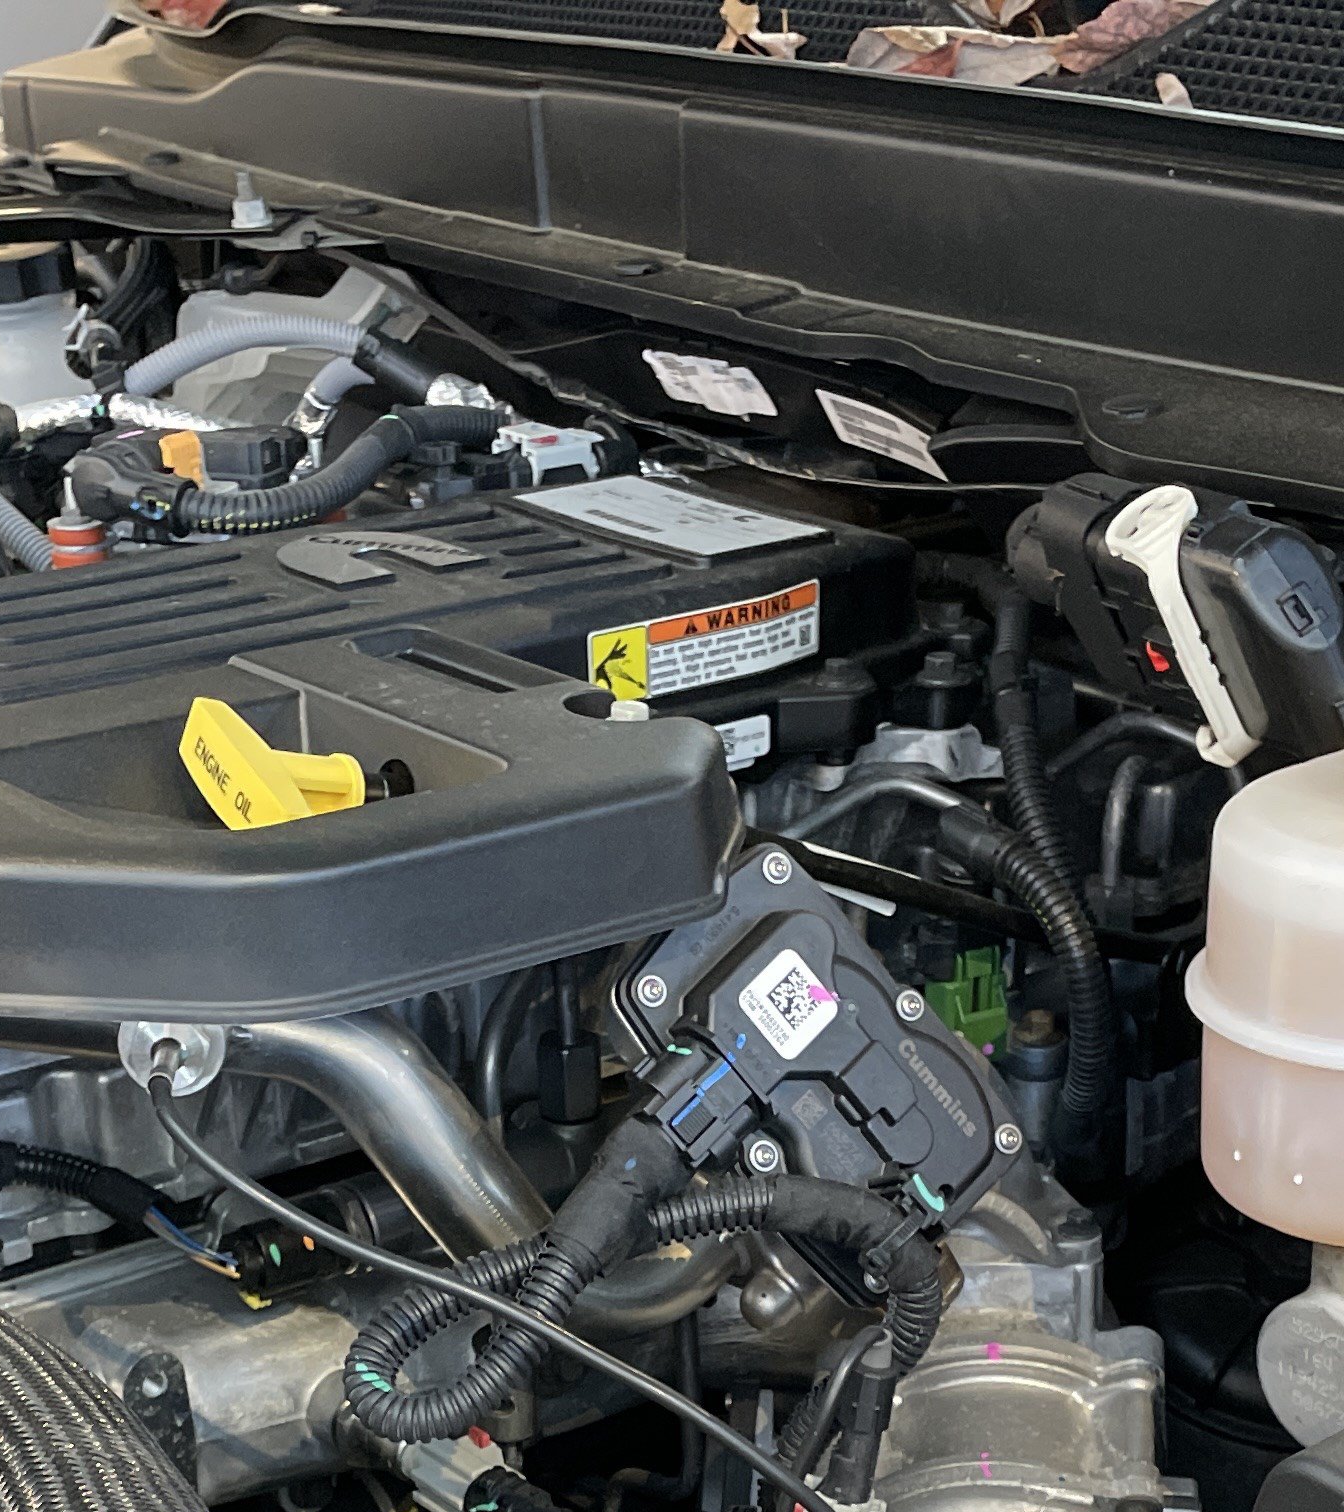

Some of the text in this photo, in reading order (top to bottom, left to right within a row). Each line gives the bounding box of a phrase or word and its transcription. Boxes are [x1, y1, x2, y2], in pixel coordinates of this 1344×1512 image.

[707, 594, 791, 629] WARNING
[194, 736, 253, 824] ENGINE OIL
[897, 1037, 978, 1139] Cummins
